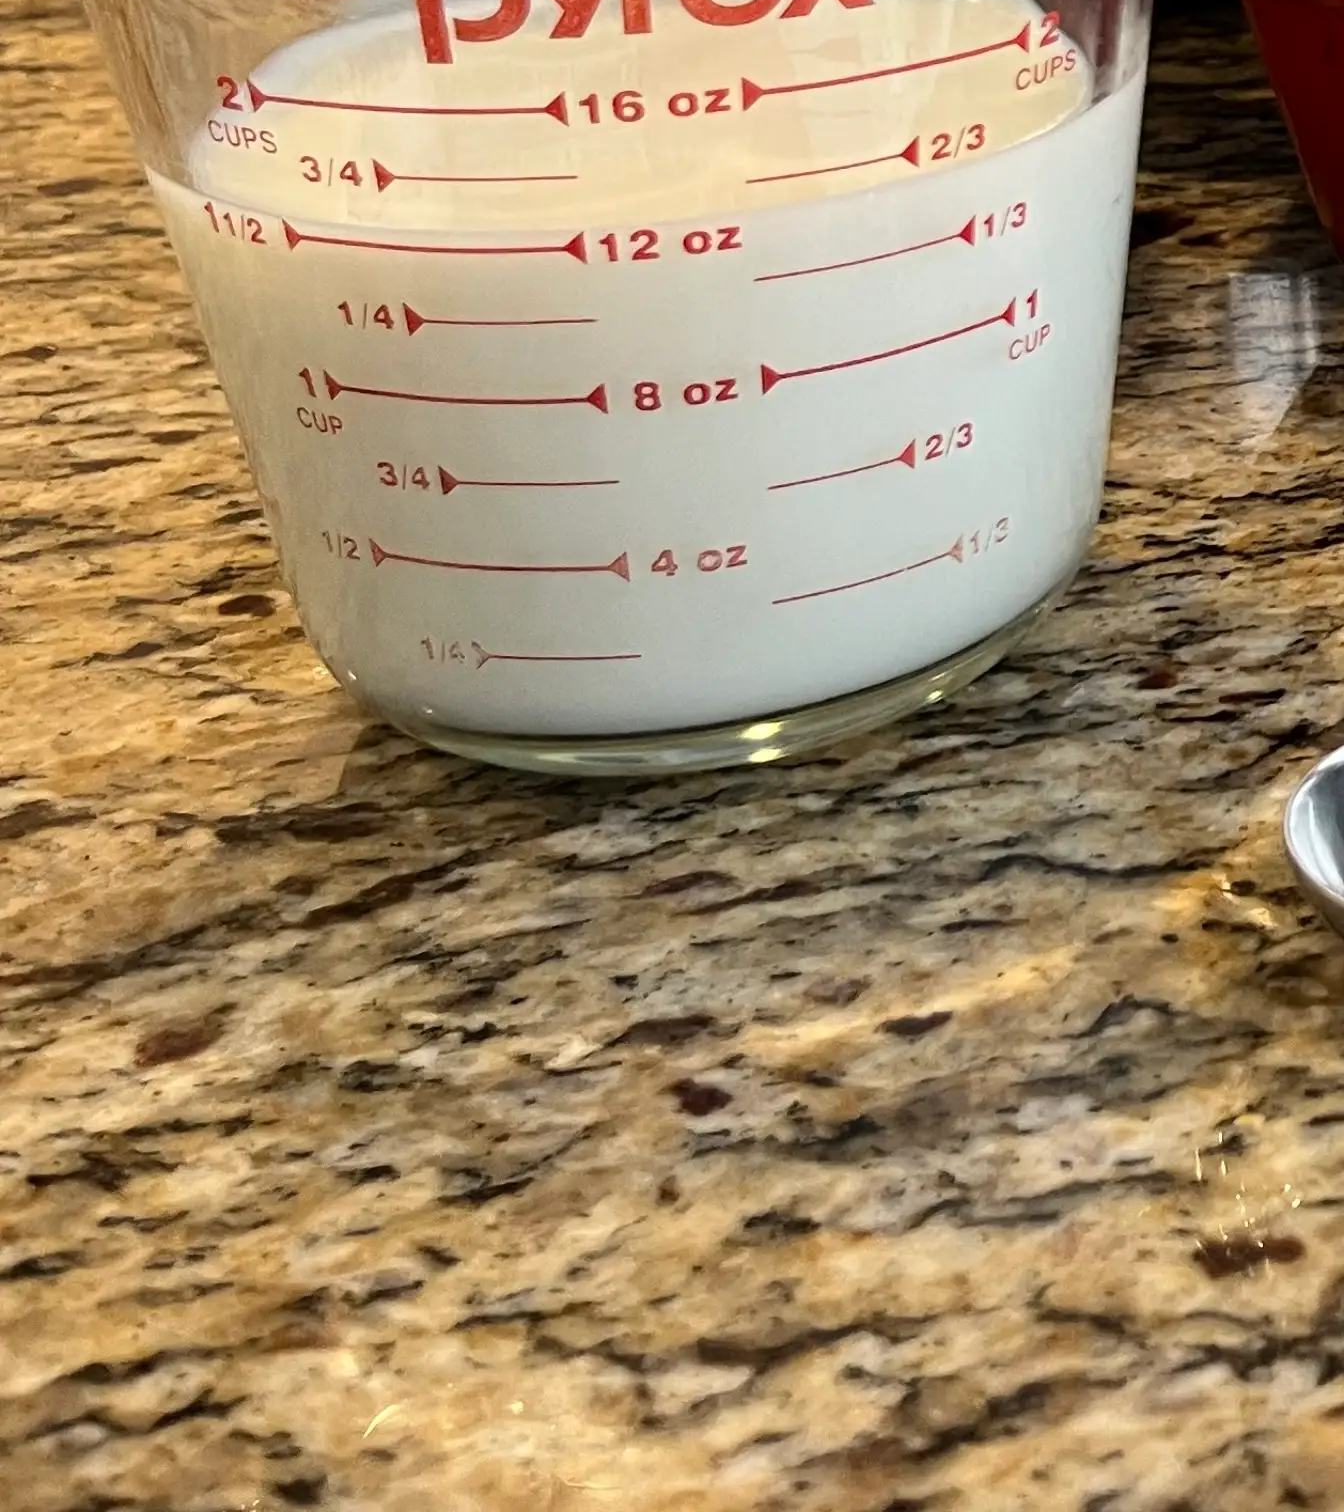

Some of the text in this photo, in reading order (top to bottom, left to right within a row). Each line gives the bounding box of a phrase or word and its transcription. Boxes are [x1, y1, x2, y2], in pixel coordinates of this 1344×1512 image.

[1039, 10, 1061, 48] 2
[1015, 49, 1077, 90] CUPS
[216, 76, 243, 111] 2
[579, 88, 732, 124] 16 oz
[207, 120, 278, 154] CUPS
[931, 123, 986, 161] 2/3
[300, 156, 363, 187] 3/4
[984, 202, 1027, 238] 1/3
[599, 227, 743, 262] 12 oz
[337, 301, 394, 330] 1/4
[1026, 288, 1038, 319] 1
[1008, 323, 1051, 360] CUP
[299, 367, 318, 398] 1
[634, 378, 739, 411] 8 oz
[296, 406, 343, 435] CUP
[925, 422, 973, 460] 2/3
[377, 461, 430, 491] 3/4
[321, 530, 361, 561] 1/2
[971, 516, 1009, 555] 1/3
[652, 544, 748, 577] 4 oz
[420, 636, 465, 664] 1/4
